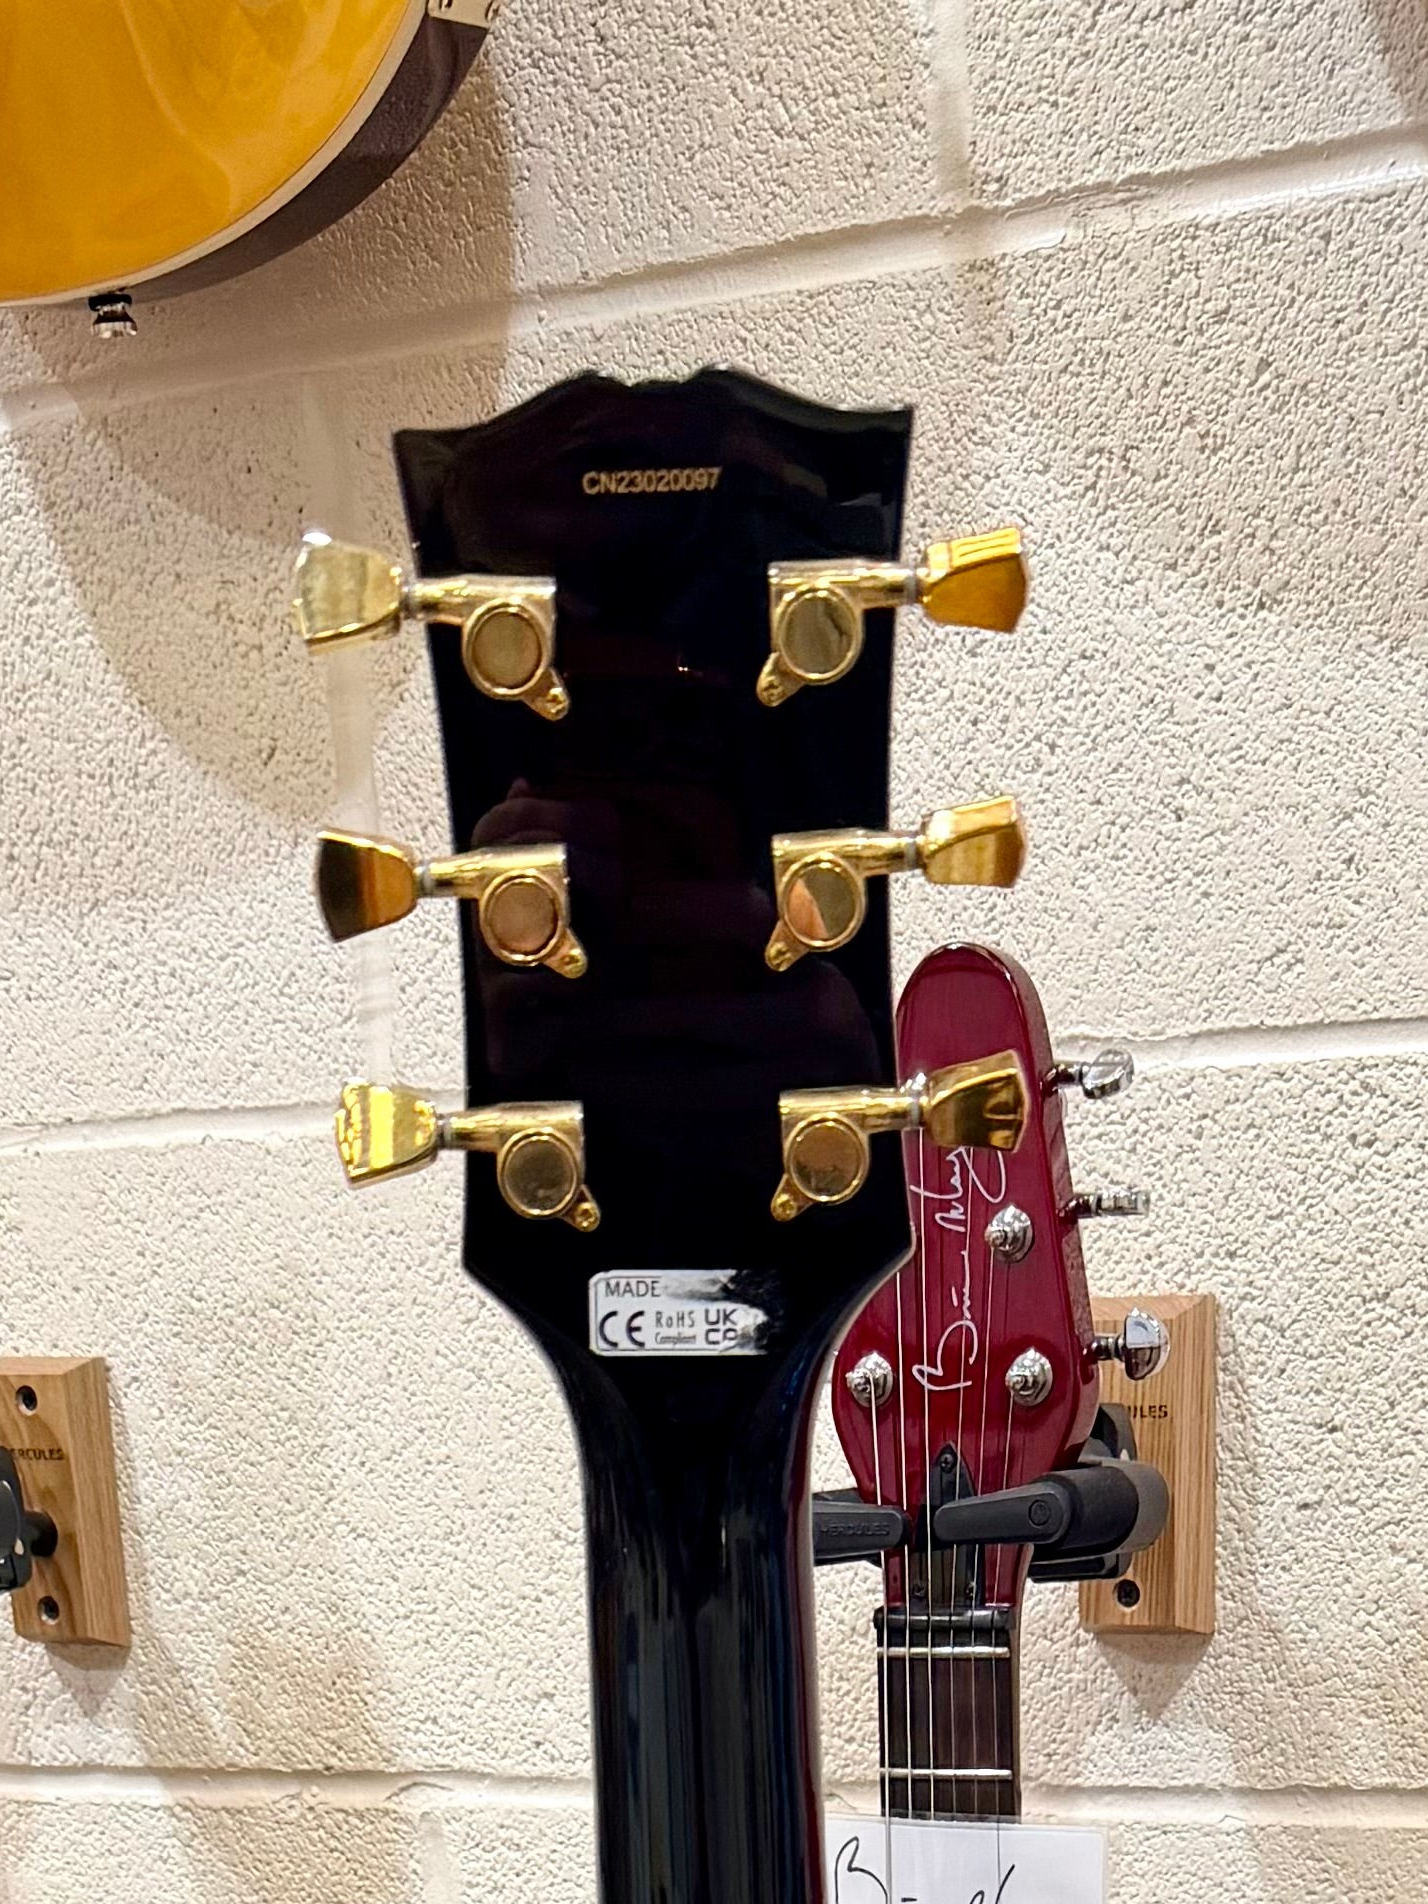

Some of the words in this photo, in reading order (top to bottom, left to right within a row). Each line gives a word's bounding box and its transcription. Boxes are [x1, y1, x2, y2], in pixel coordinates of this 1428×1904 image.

[582, 466, 722, 494] CN23020097
[605, 1281, 661, 1297] MADE
[655, 1311, 695, 1328] RoHS
